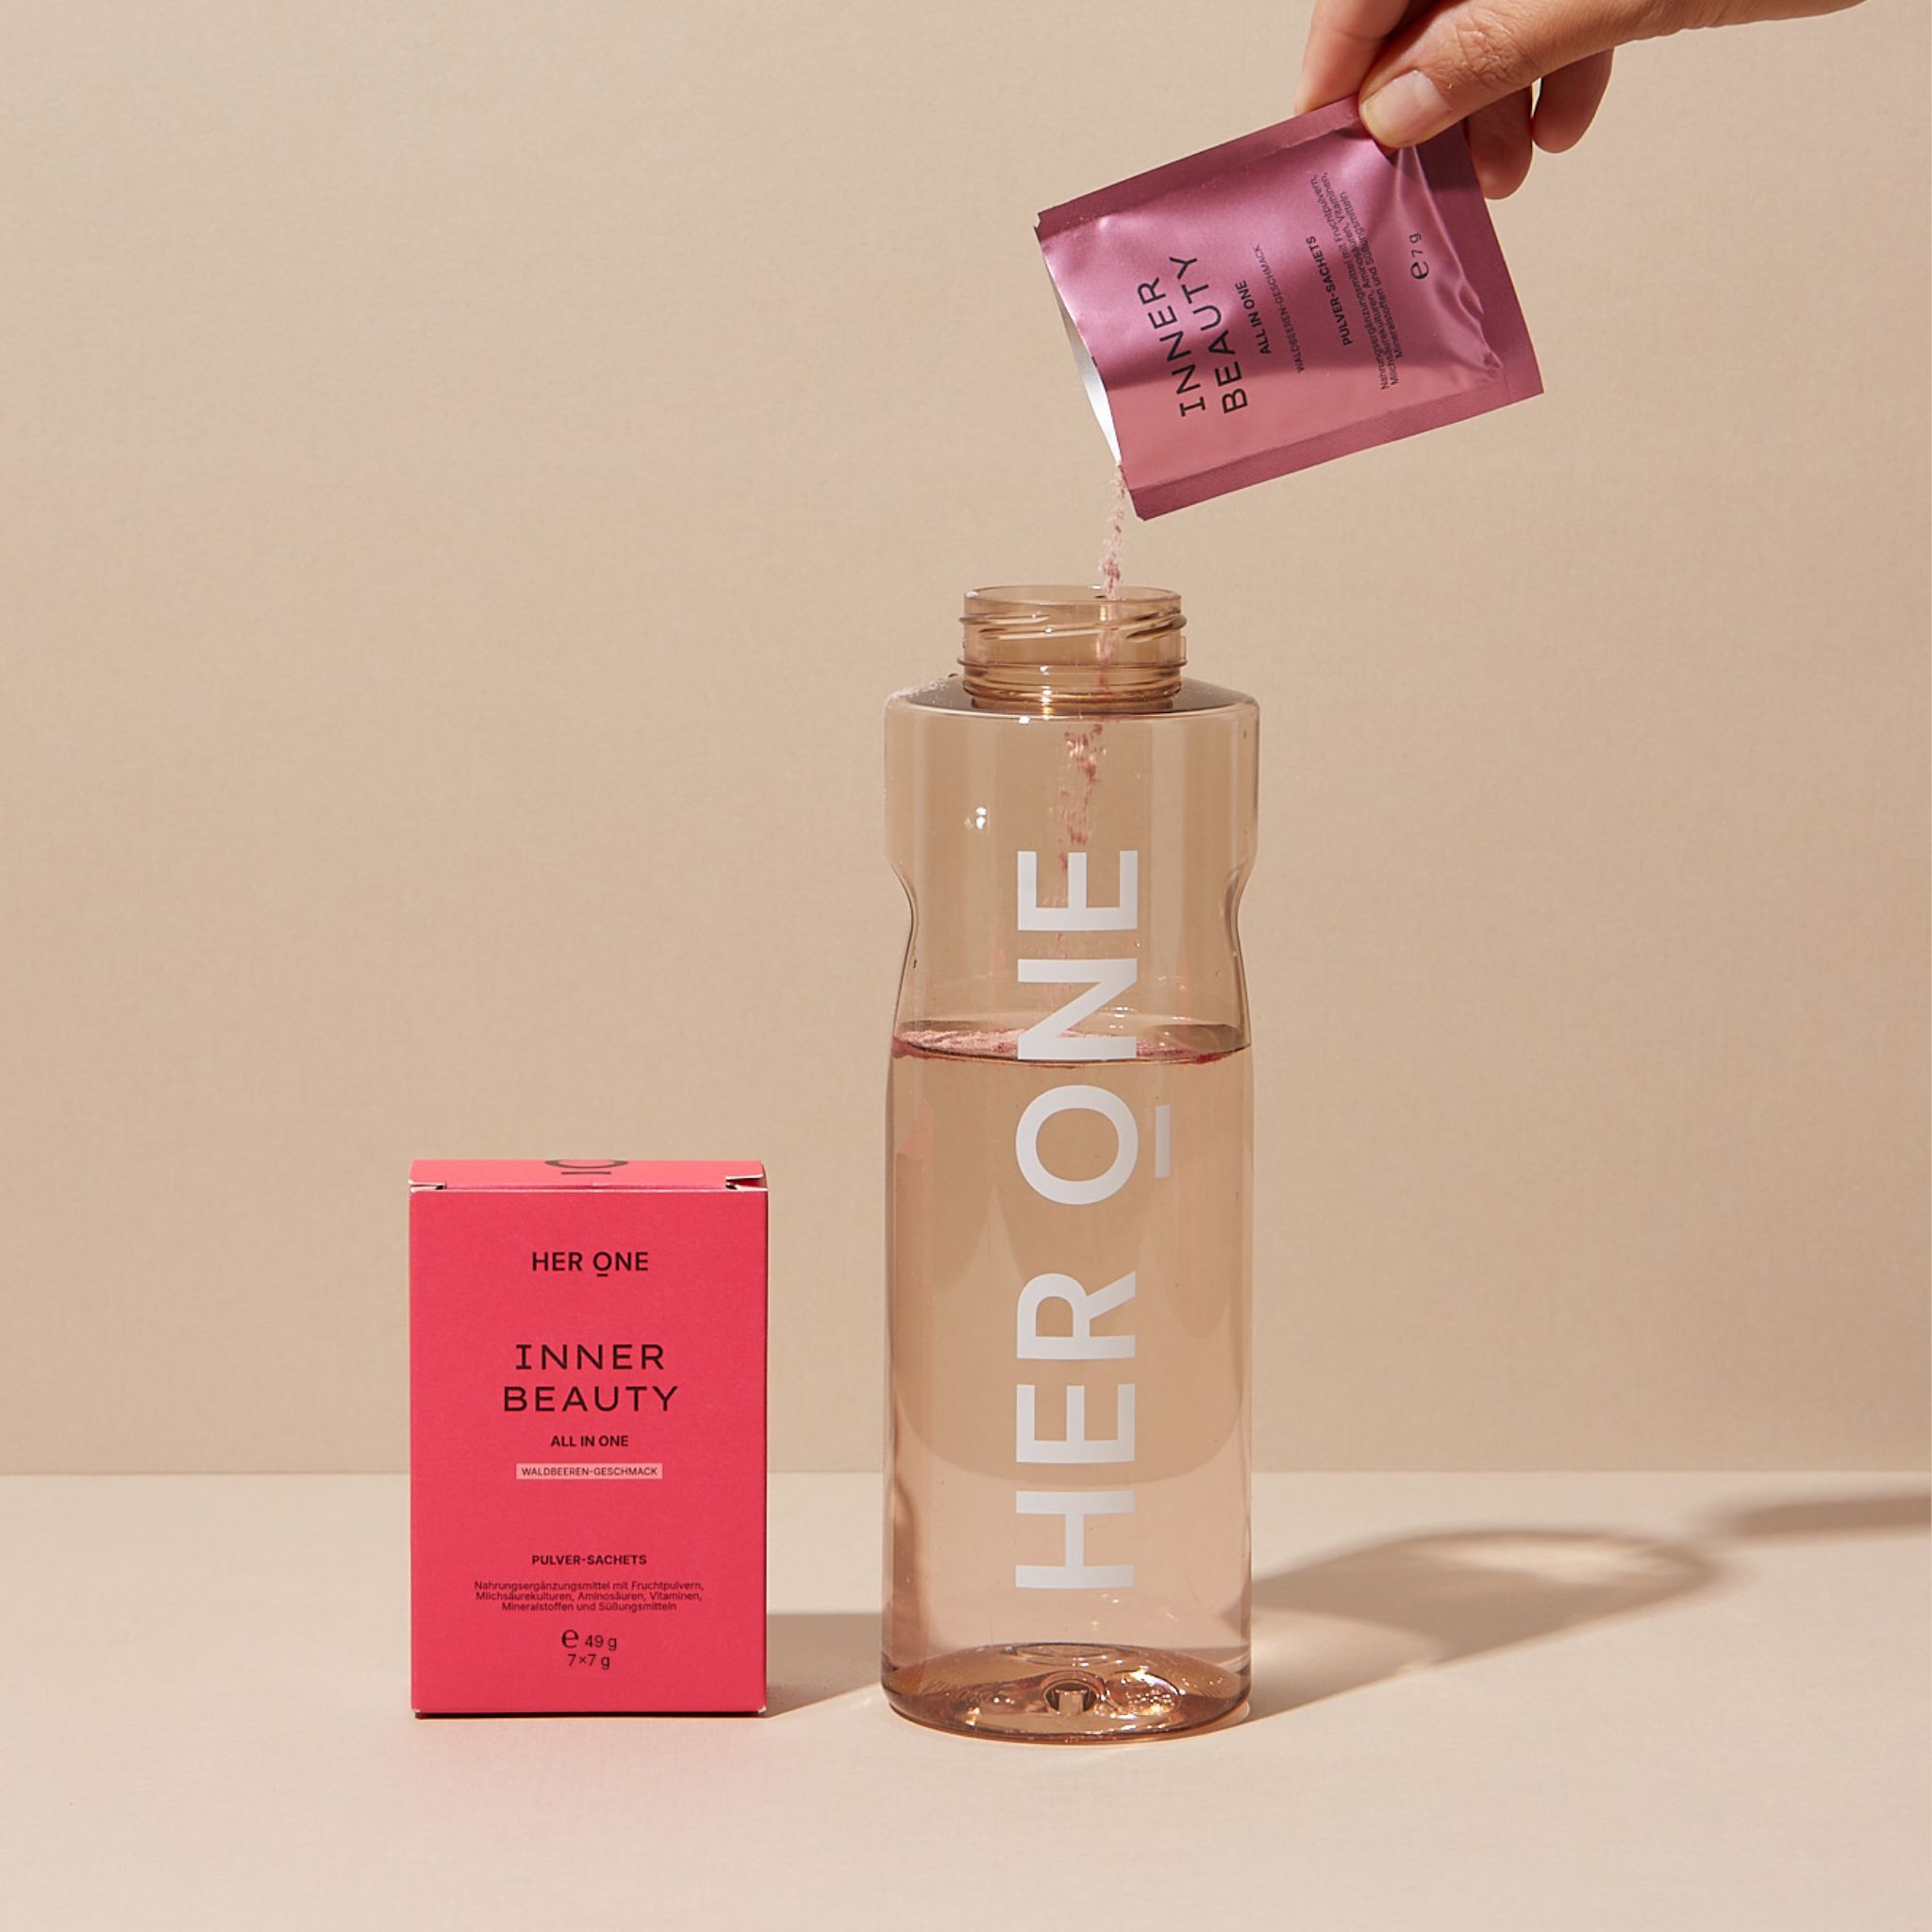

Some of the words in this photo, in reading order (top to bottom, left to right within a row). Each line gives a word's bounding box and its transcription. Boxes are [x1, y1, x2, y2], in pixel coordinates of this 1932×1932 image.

[1409, 233, 1422, 243] g
[1338, 242, 1351, 259] mit
[1411, 249, 1424, 258] 7
[1369, 266, 1382, 286] und
[1235, 279, 1256, 309] ONE
[1306, 236, 1353, 346] PULVER-SACHETS
[1253, 244, 1305, 373] WALDBEEREN-GESCHMACK
[1248, 311, 1262, 327] IN
[1169, 257, 1248, 414] BEAUTY
[1255, 328, 1272, 354] ALL
[1137, 276, 1206, 417] INNER
[1016, 851, 1171, 1205] ONE
[532, 1252, 583, 1272] HER
[592, 1252, 649, 1277] ONE
[515, 1344, 665, 1370] INNER
[504, 1386, 678, 1411] BEAUTY
[1016, 1271, 1136, 1589] HER
[550, 1435, 577, 1447] ALL
[580, 1435, 596, 1447] IN
[598, 1435, 629, 1447] ONE
[522, 1467, 658, 1476] WALDBEEREN-GESCHMACK
[531, 1555, 647, 1566] PULVER-SACHETS
[475, 1580, 610, 1591] Nahrungsergänzungsmittel
[612, 1580, 628, 1590] mit
[631, 1580, 705, 1591] Fruchtpulvern,
[475, 1591, 575, 1602] Milchsäurekulturen,
[577, 1591, 647, 1602] Aminosäuren,
[649, 1591, 703, 1602] Vitaminen,
[502, 1602, 575, 1611] Mineralstoffen
[576, 1602, 596, 1611] und
[584, 1635, 604, 1648] 49
[607, 1637, 618, 1651] g
[600, 1656, 611, 1671] g
